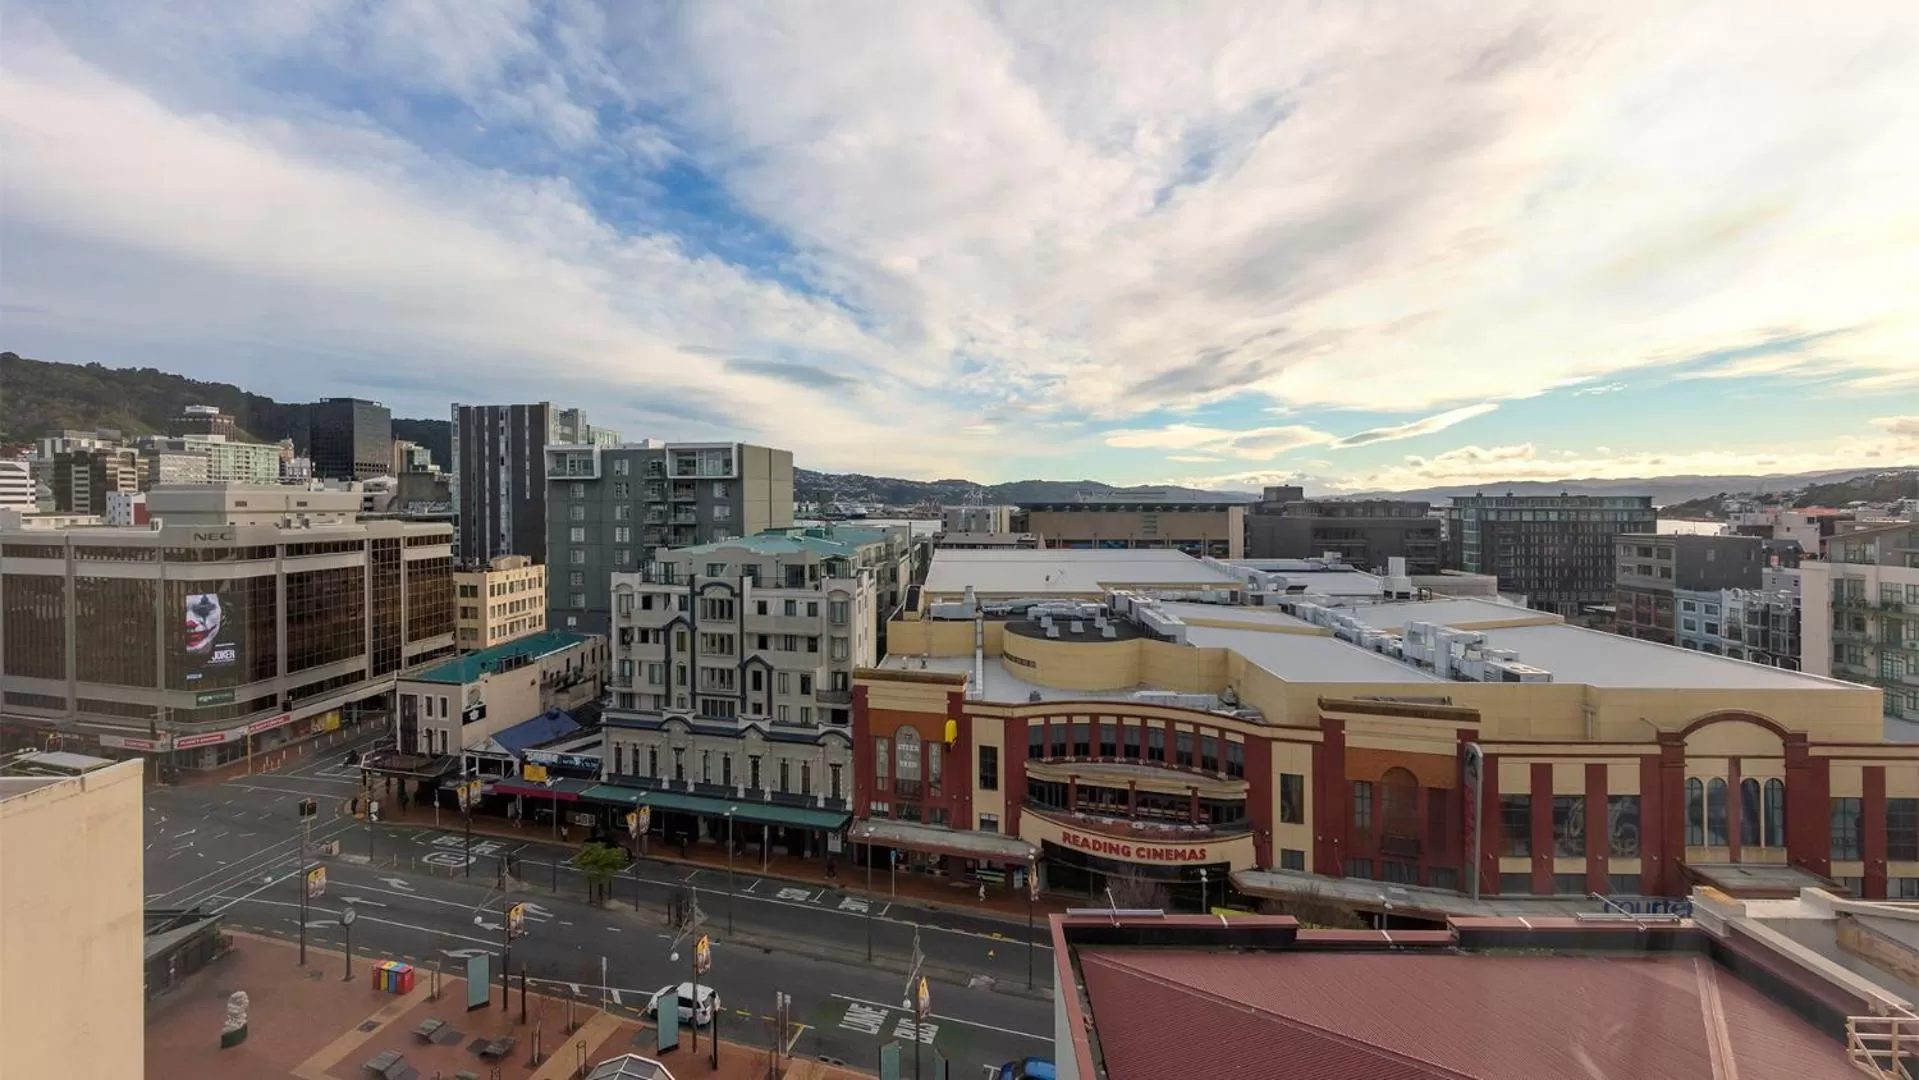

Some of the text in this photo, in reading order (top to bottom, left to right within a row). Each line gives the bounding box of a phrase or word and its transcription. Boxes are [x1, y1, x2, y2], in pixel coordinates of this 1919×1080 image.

[193, 531, 233, 542] NEC
[1061, 831, 1207, 861] READING CINEMAS
